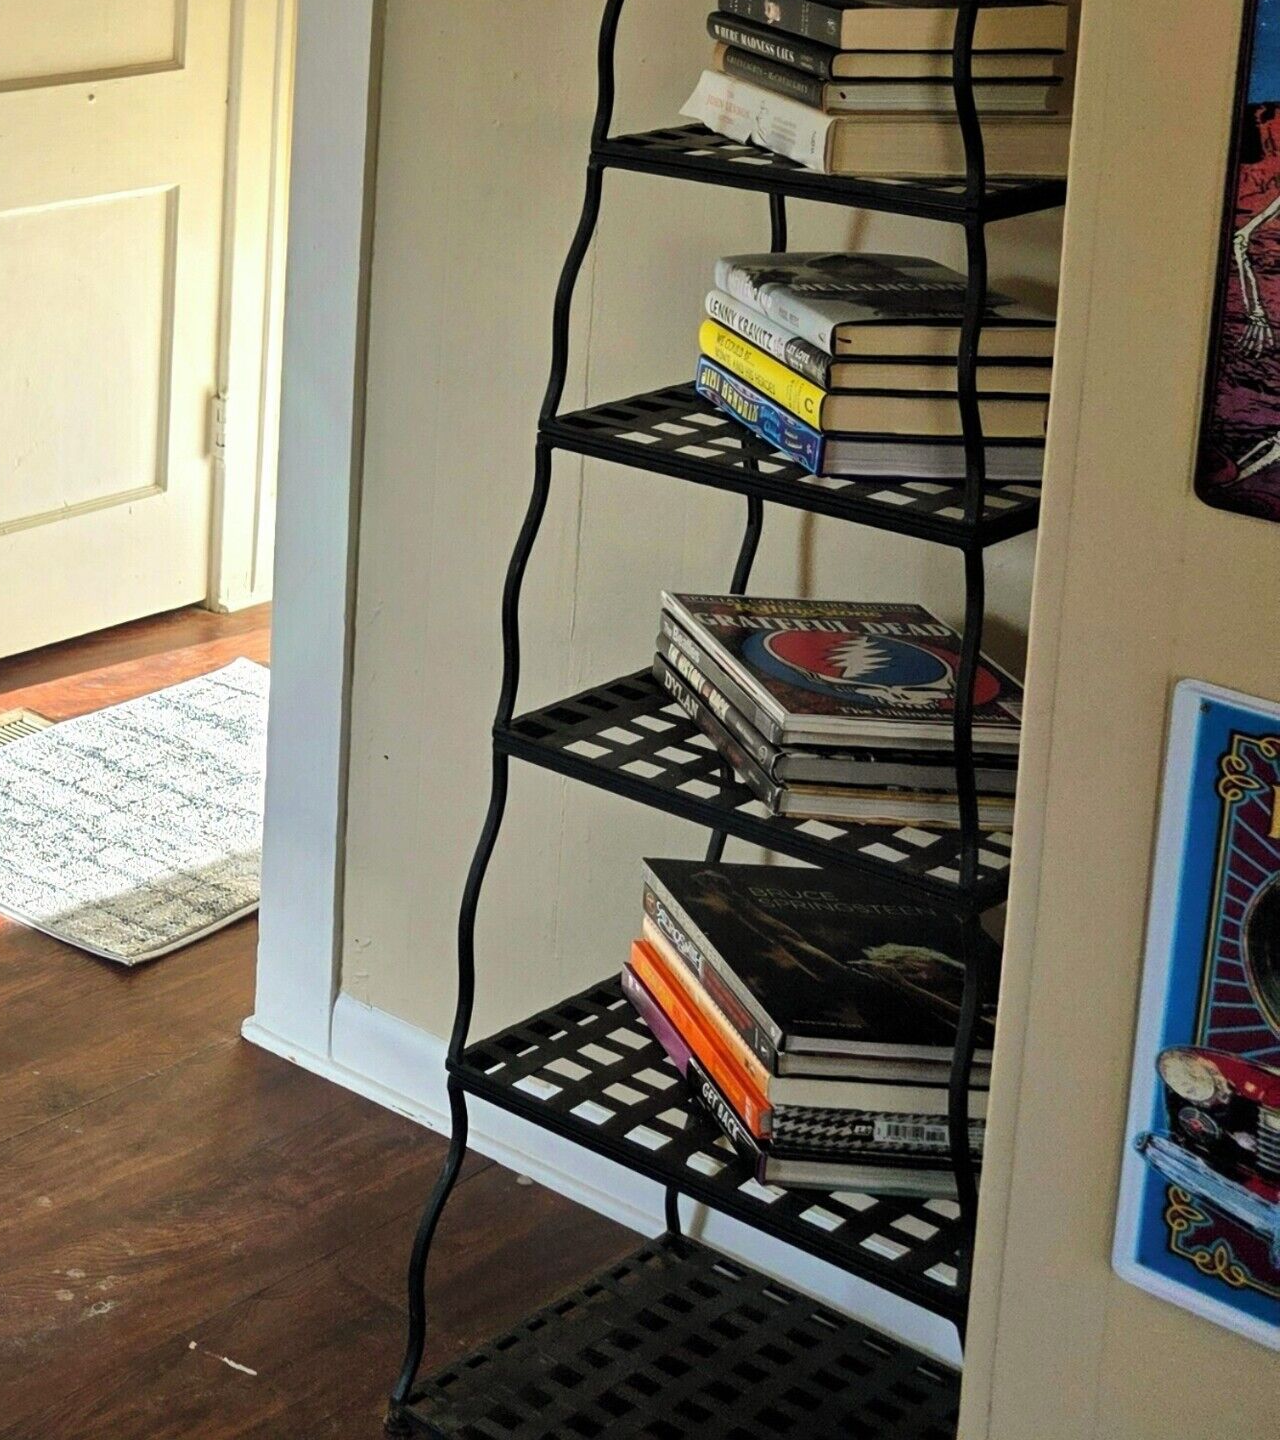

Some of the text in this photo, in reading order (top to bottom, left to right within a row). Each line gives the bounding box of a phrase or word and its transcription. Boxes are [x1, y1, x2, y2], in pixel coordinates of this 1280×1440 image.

[714, 24, 795, 62] WHERE MADNESS LIES
[709, 297, 737, 324] LENNY
[738, 317, 773, 351] KRAVITZ
[701, 367, 759, 423] JIMI HENDRIX
[693, 612, 951, 637] GRATEFUL DEAD
[664, 670, 699, 721] DYLAN
[747, 886, 839, 901] BRUCE
[756, 898, 937, 916] SPRINGSTEEN
[702, 1082, 740, 1143] GET BACK
